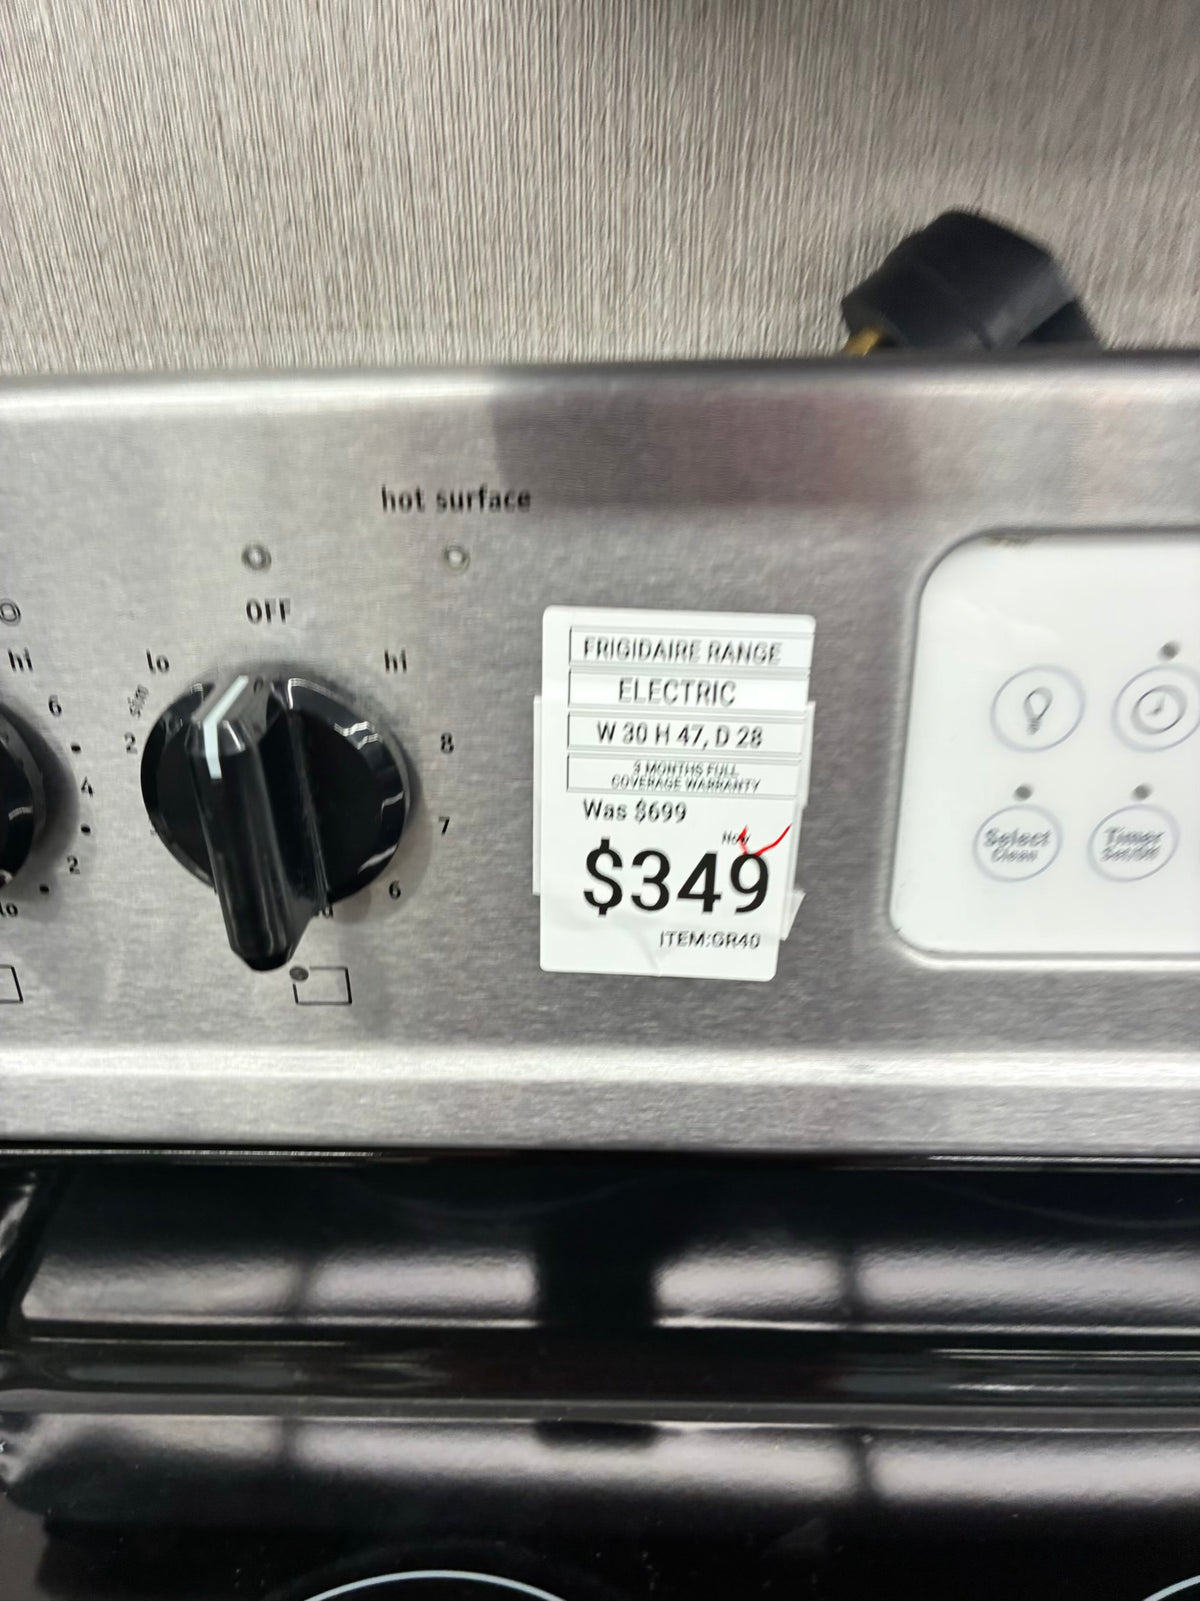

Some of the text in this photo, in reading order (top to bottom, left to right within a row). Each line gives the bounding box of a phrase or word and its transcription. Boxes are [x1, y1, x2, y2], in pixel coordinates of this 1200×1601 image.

[381, 483, 531, 513] hot surface
[246, 598, 291, 624] OFF
[7, 648, 34, 672] hi
[145, 648, 170, 674] lo
[384, 649, 408, 673] hi
[583, 636, 783, 665] FRIGIDAIRE RANGE
[618, 677, 737, 707] ELECTRIC
[48, 694, 62, 717] 6
[124, 732, 138, 754] 2
[440, 732, 454, 754] 8
[597, 721, 764, 751] W 30 H 47, D 28
[645, 760, 704, 777] MONTHS
[707, 762, 739, 778] FULL
[81, 776, 94, 798] 4
[611, 774, 761, 793] COVERAGE WARRANTY
[583, 797, 687, 825] Was $699
[438, 815, 451, 836] 7
[984, 827, 1051, 848] Select
[66, 855, 81, 876] 2
[991, 847, 1038, 862] Clean
[583, 836, 769, 917] $349
[388, 880, 402, 900] 6
[659, 930, 761, 950] ITEM:GR40
